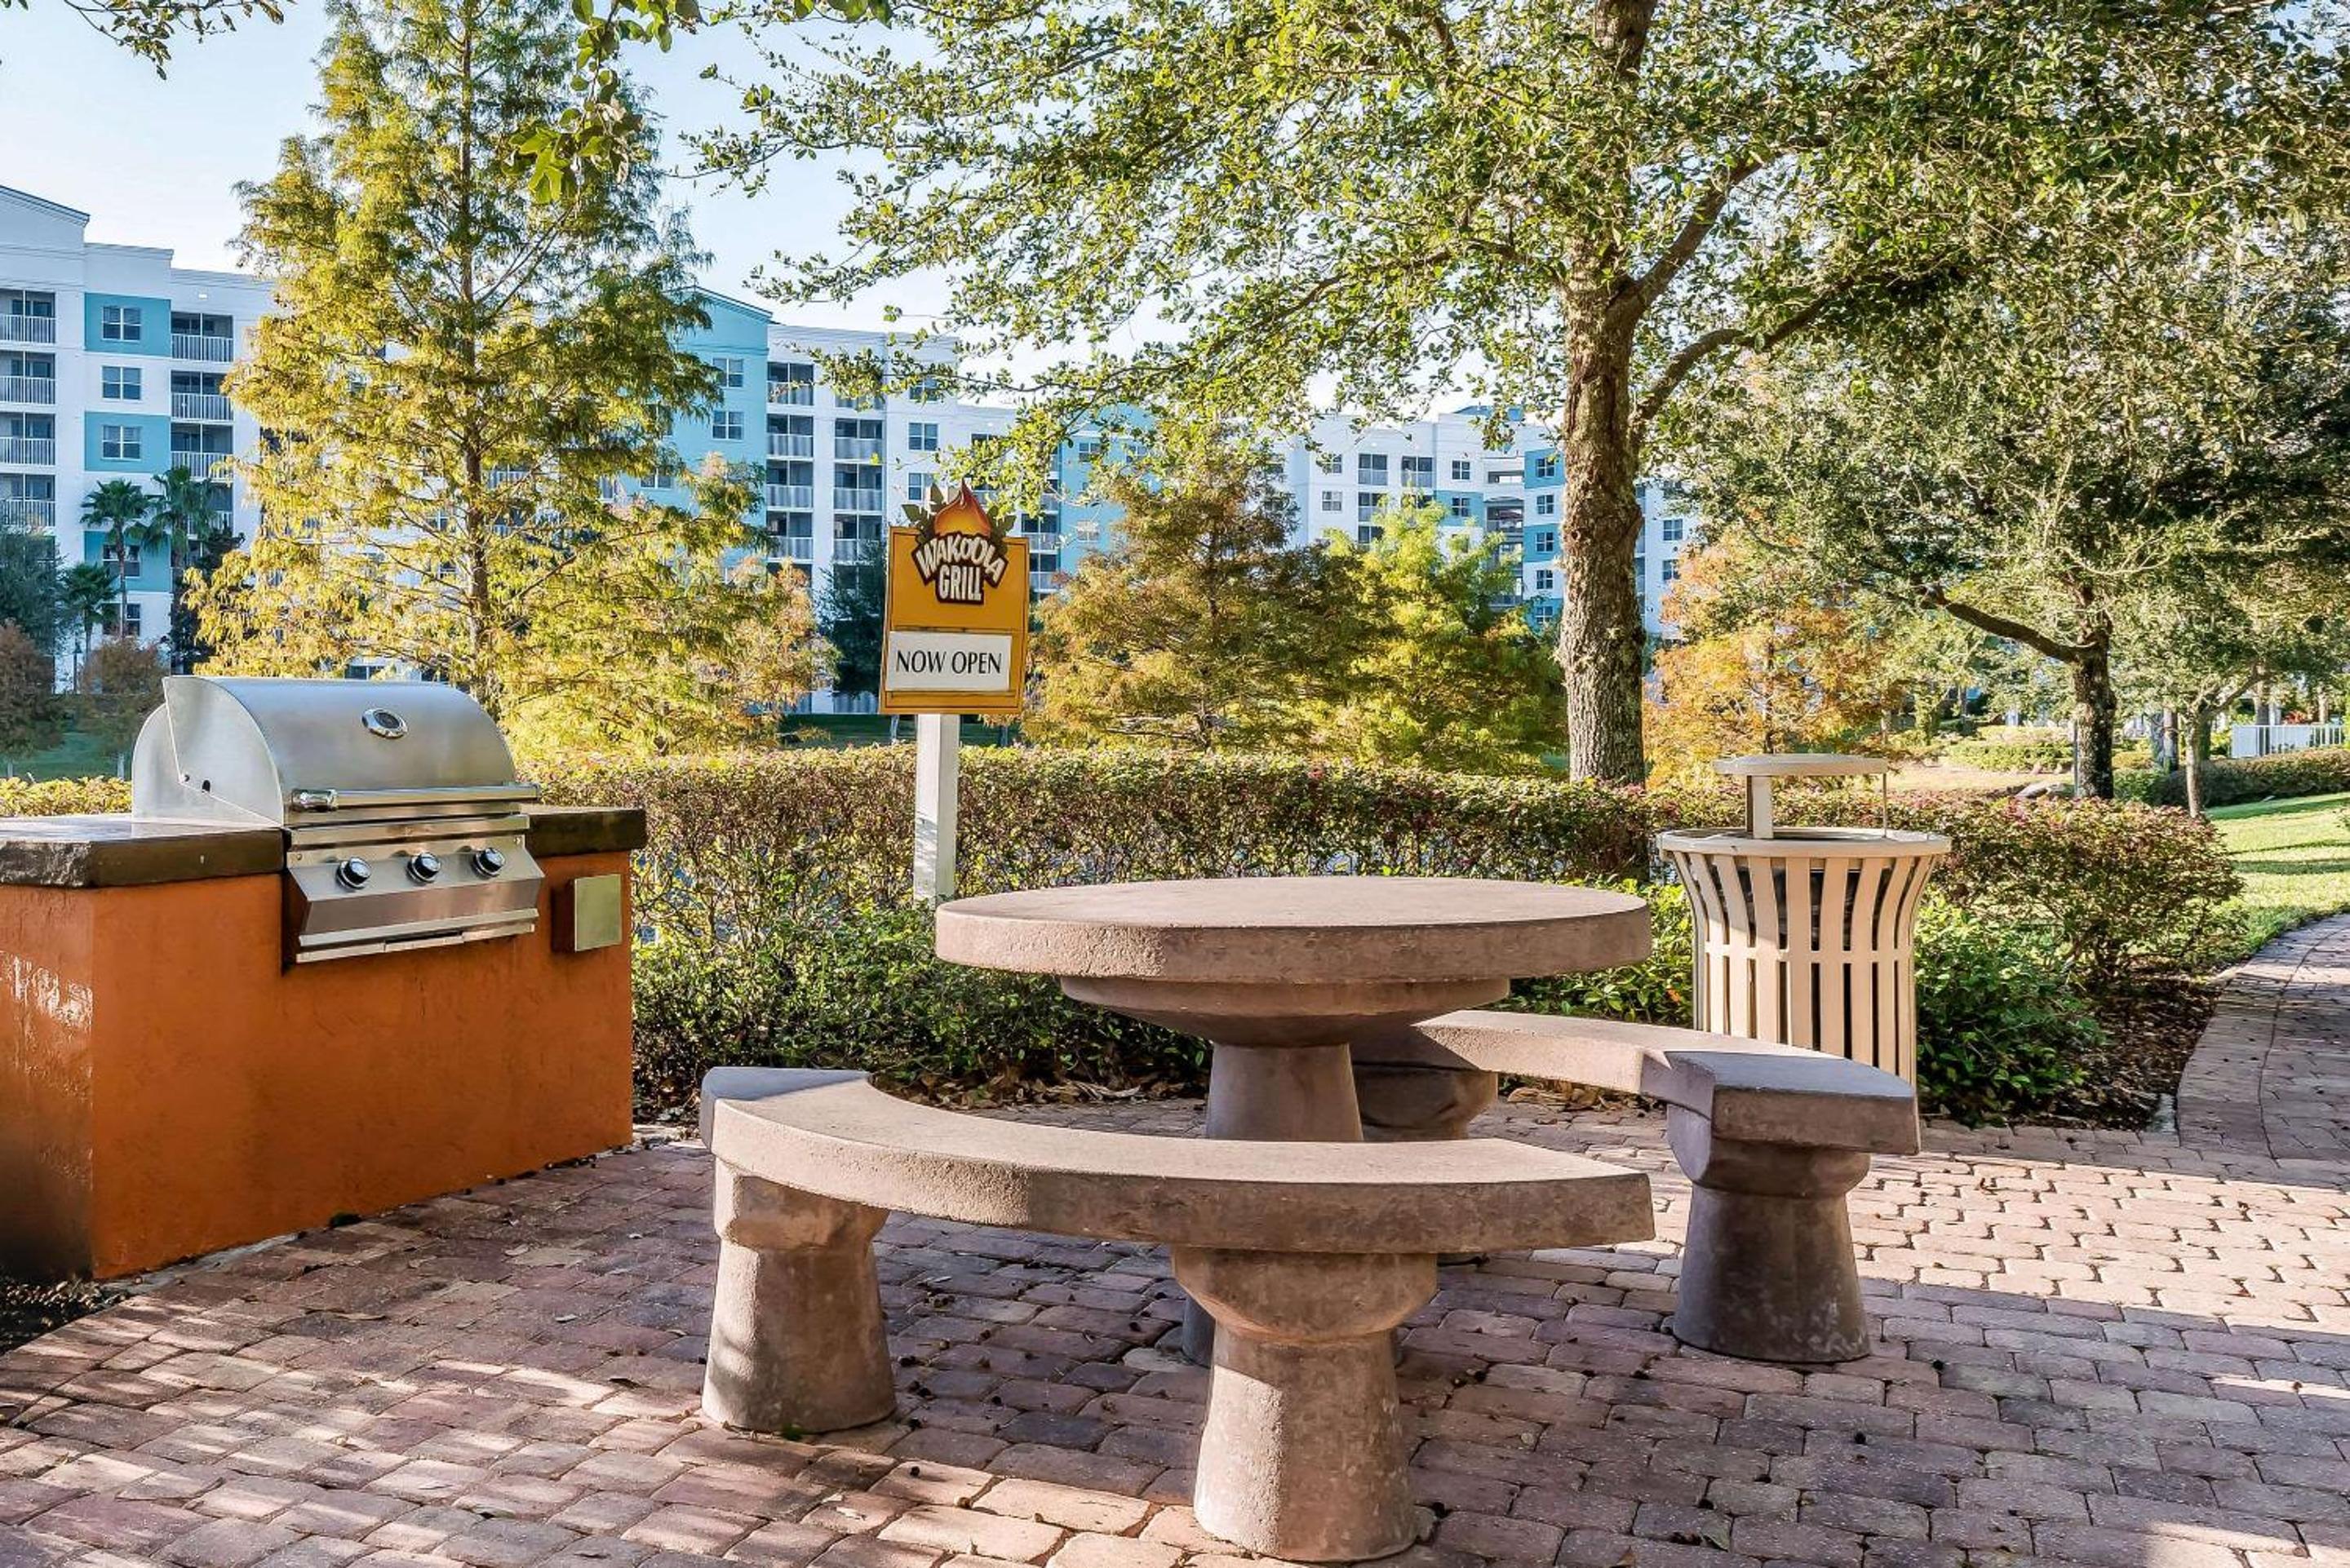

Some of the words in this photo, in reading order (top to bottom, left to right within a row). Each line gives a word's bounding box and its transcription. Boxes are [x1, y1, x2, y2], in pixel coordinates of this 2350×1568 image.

[915, 533, 1006, 583] WAKOOLA
[938, 564, 982, 601] GRILL
[896, 650, 947, 673] NOW
[951, 651, 1002, 674] OPEN
